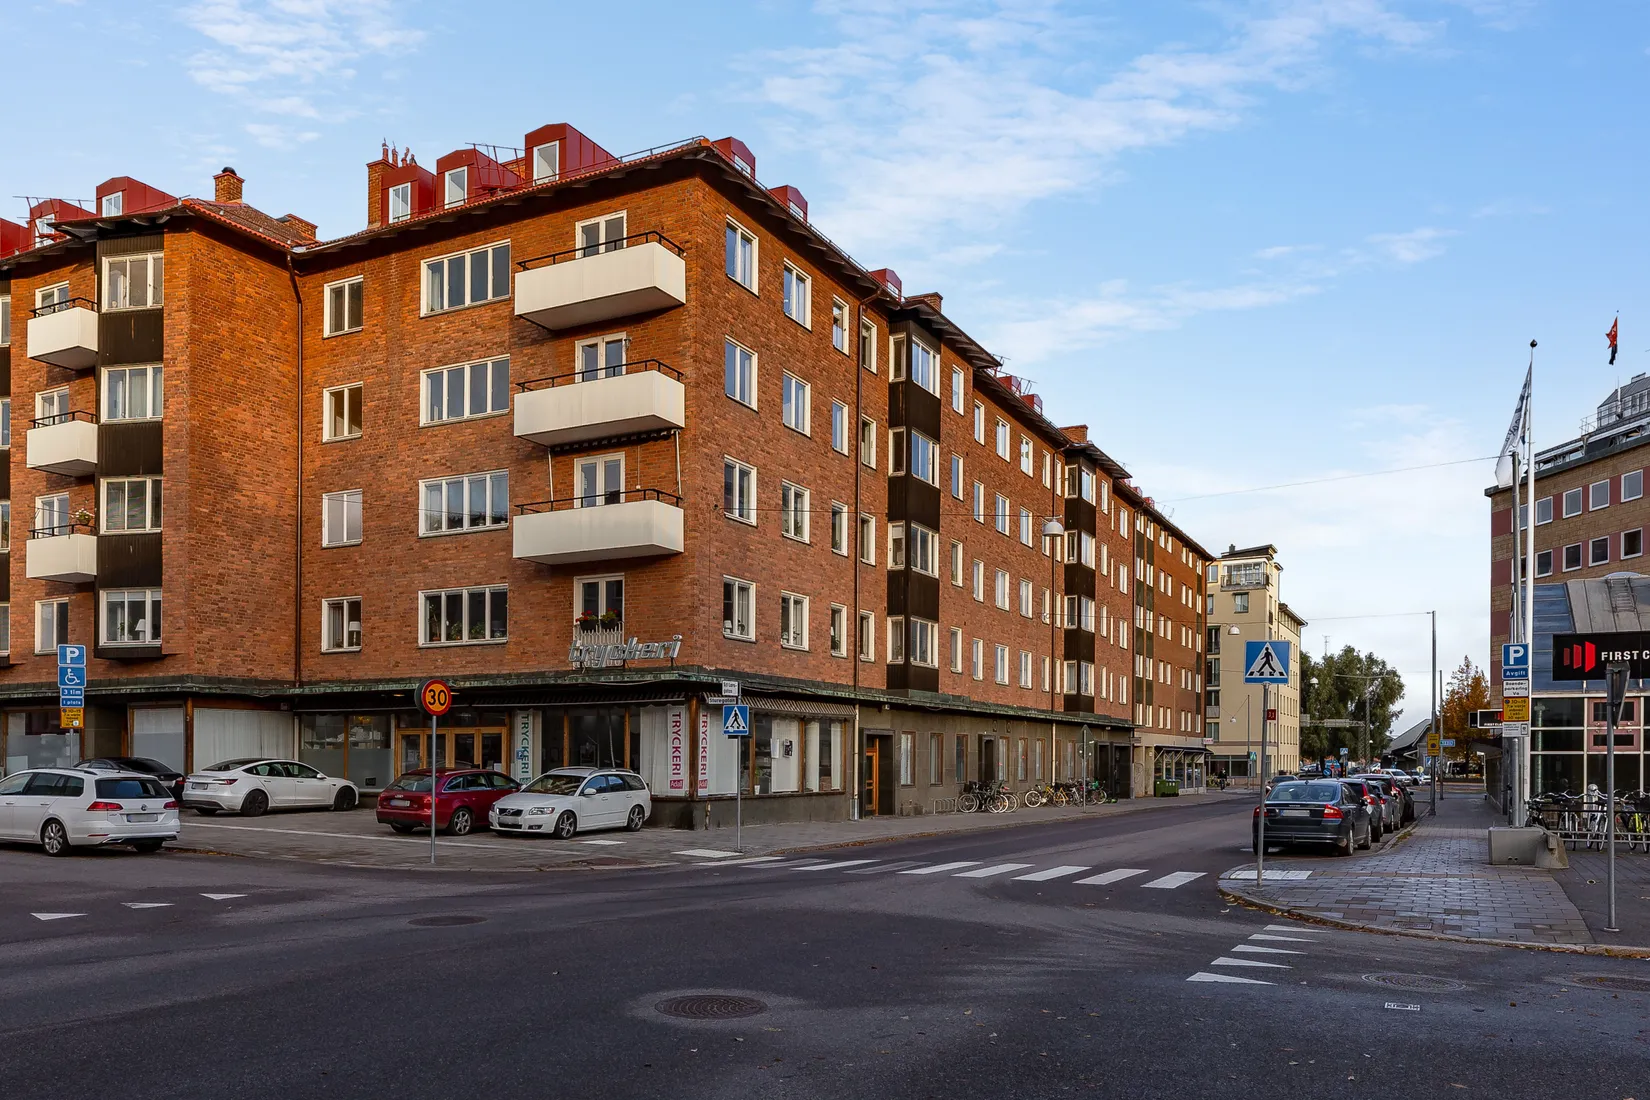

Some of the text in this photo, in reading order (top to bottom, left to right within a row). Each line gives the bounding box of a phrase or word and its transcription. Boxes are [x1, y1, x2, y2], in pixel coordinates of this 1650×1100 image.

[66, 647, 79, 664] P
[569, 635, 682, 667] tryckeri
[1509, 645, 1524, 664] P
[1601, 650, 1639, 661] FIRST
[427, 688, 448, 707] 30
[521, 714, 530, 774] TRYCKERI
[672, 711, 682, 776] TRYCKERI
